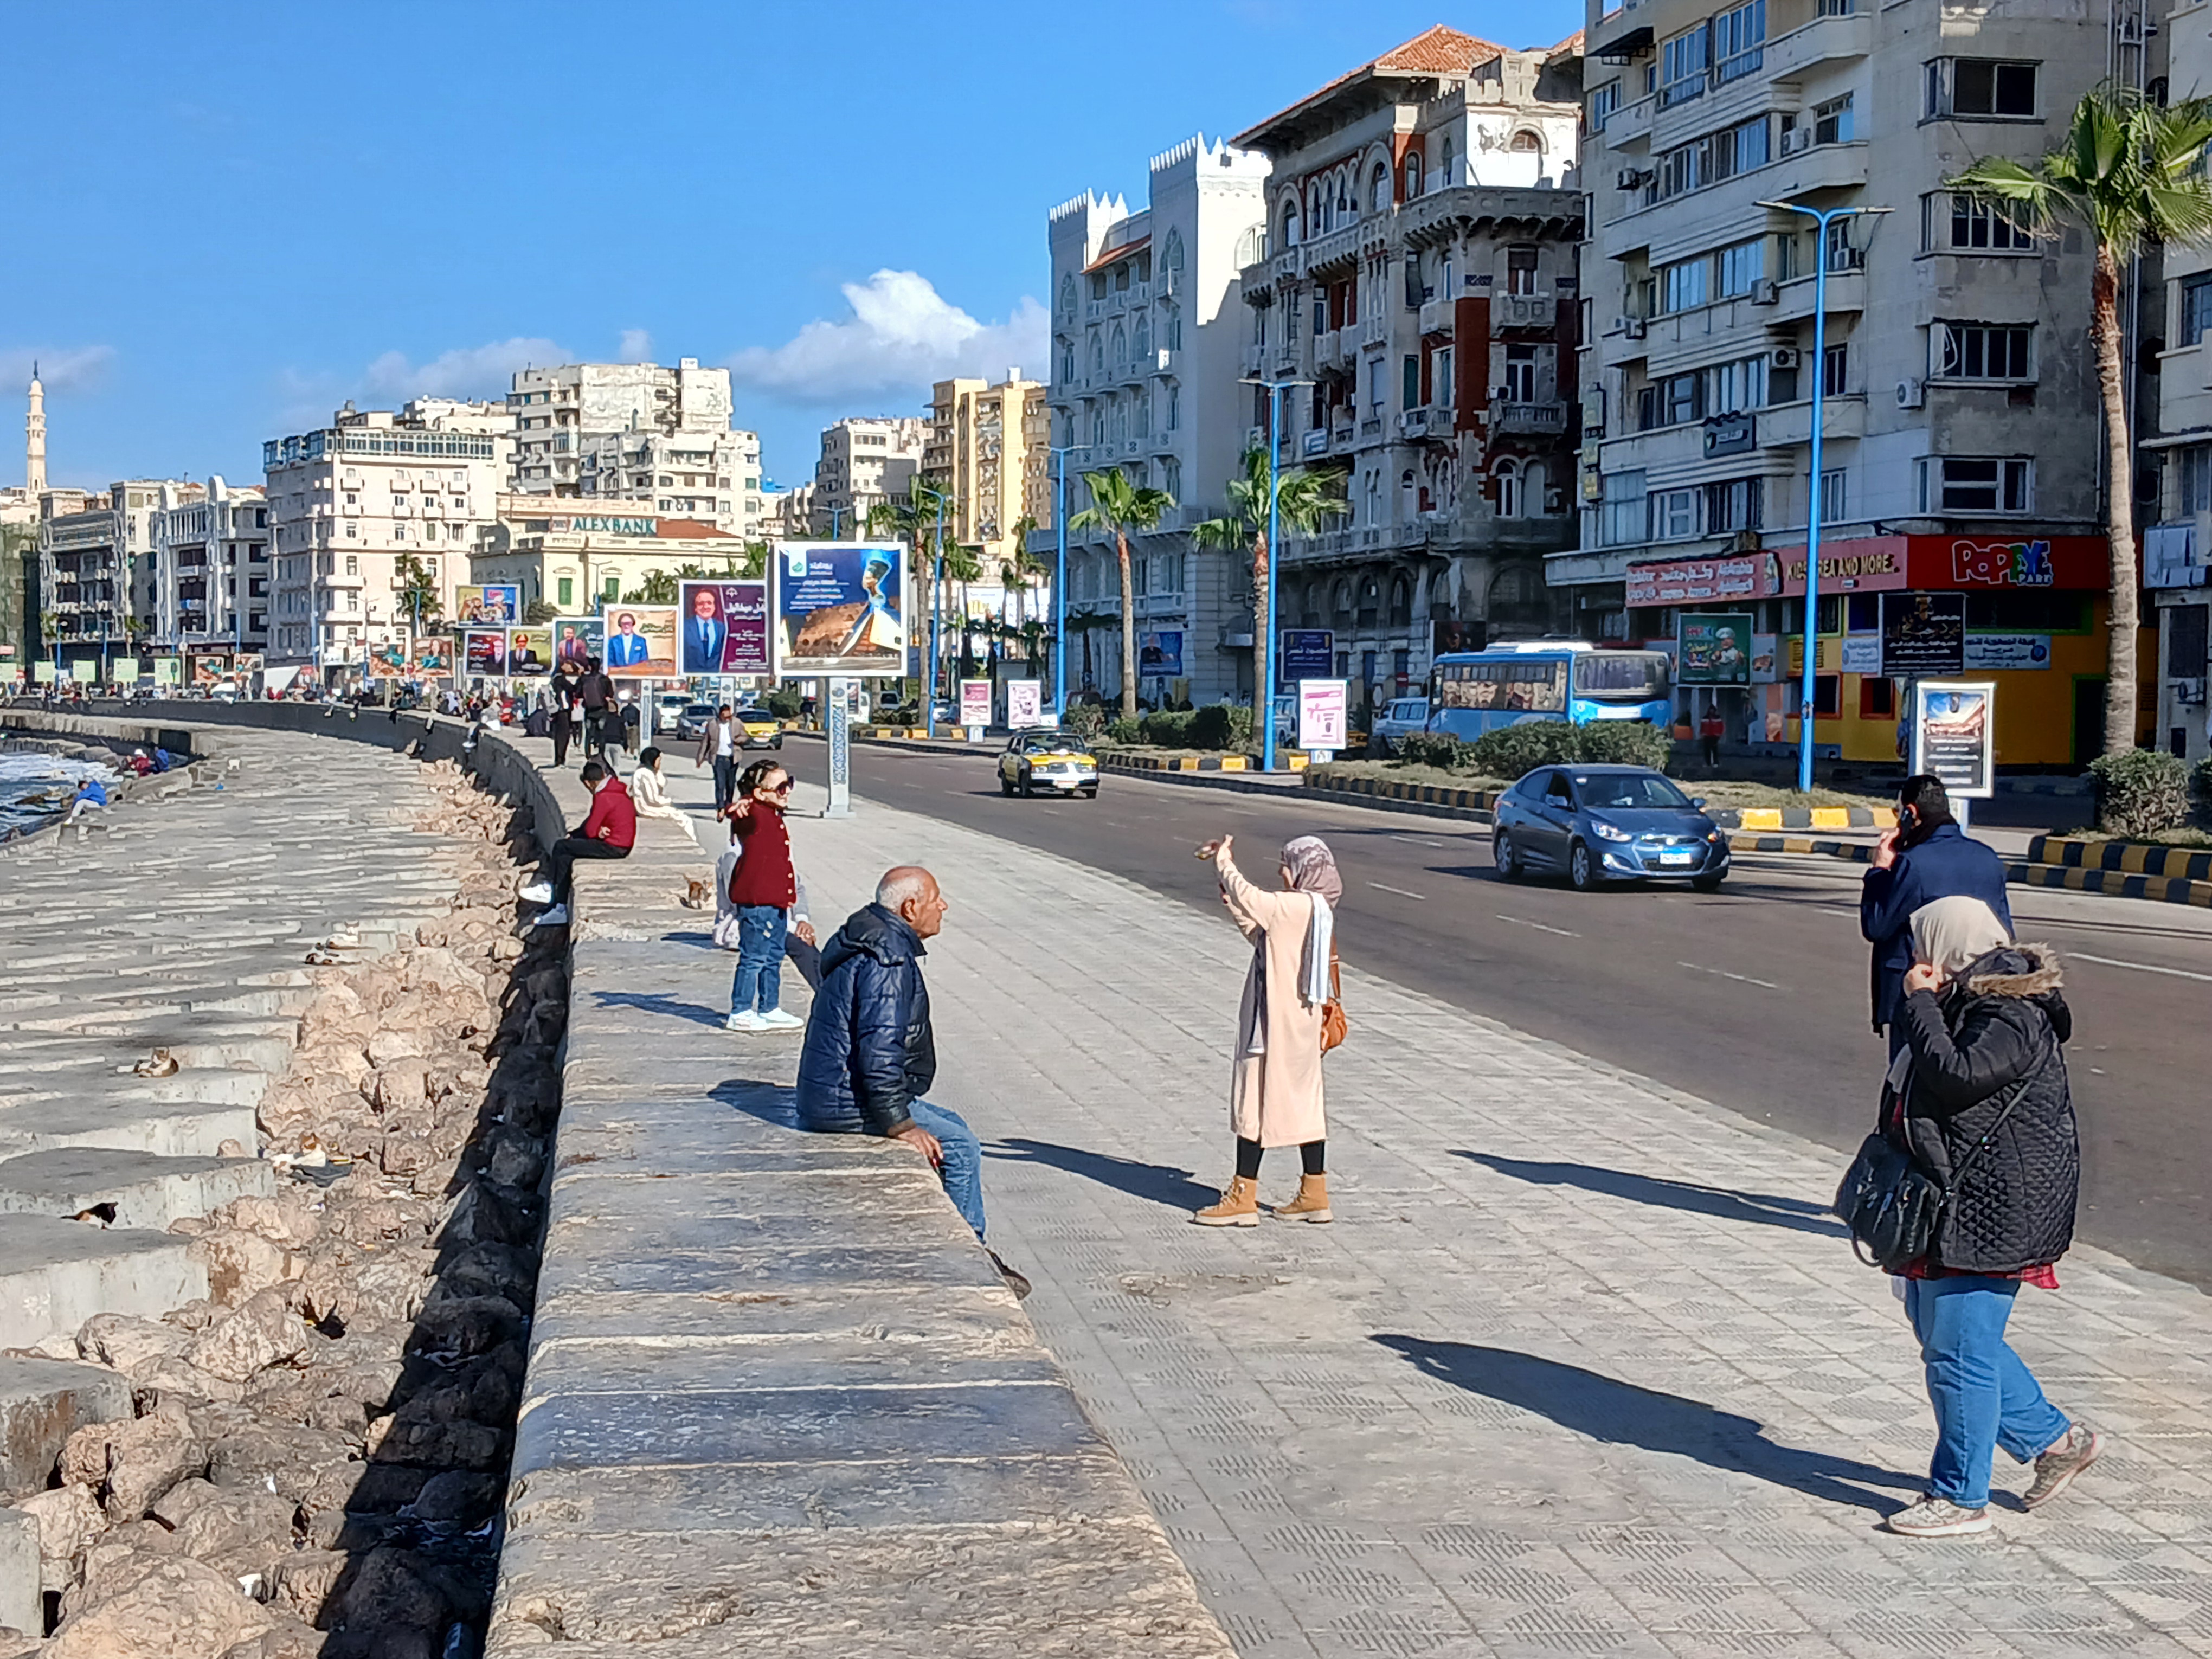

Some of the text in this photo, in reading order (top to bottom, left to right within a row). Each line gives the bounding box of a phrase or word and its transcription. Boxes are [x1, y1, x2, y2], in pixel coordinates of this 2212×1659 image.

[572, 516, 655, 535] ALEXBANK
[1818, 558, 1835, 578] REA
[1838, 556, 1859, 577] AND
[1861, 554, 1895, 575] MORE
